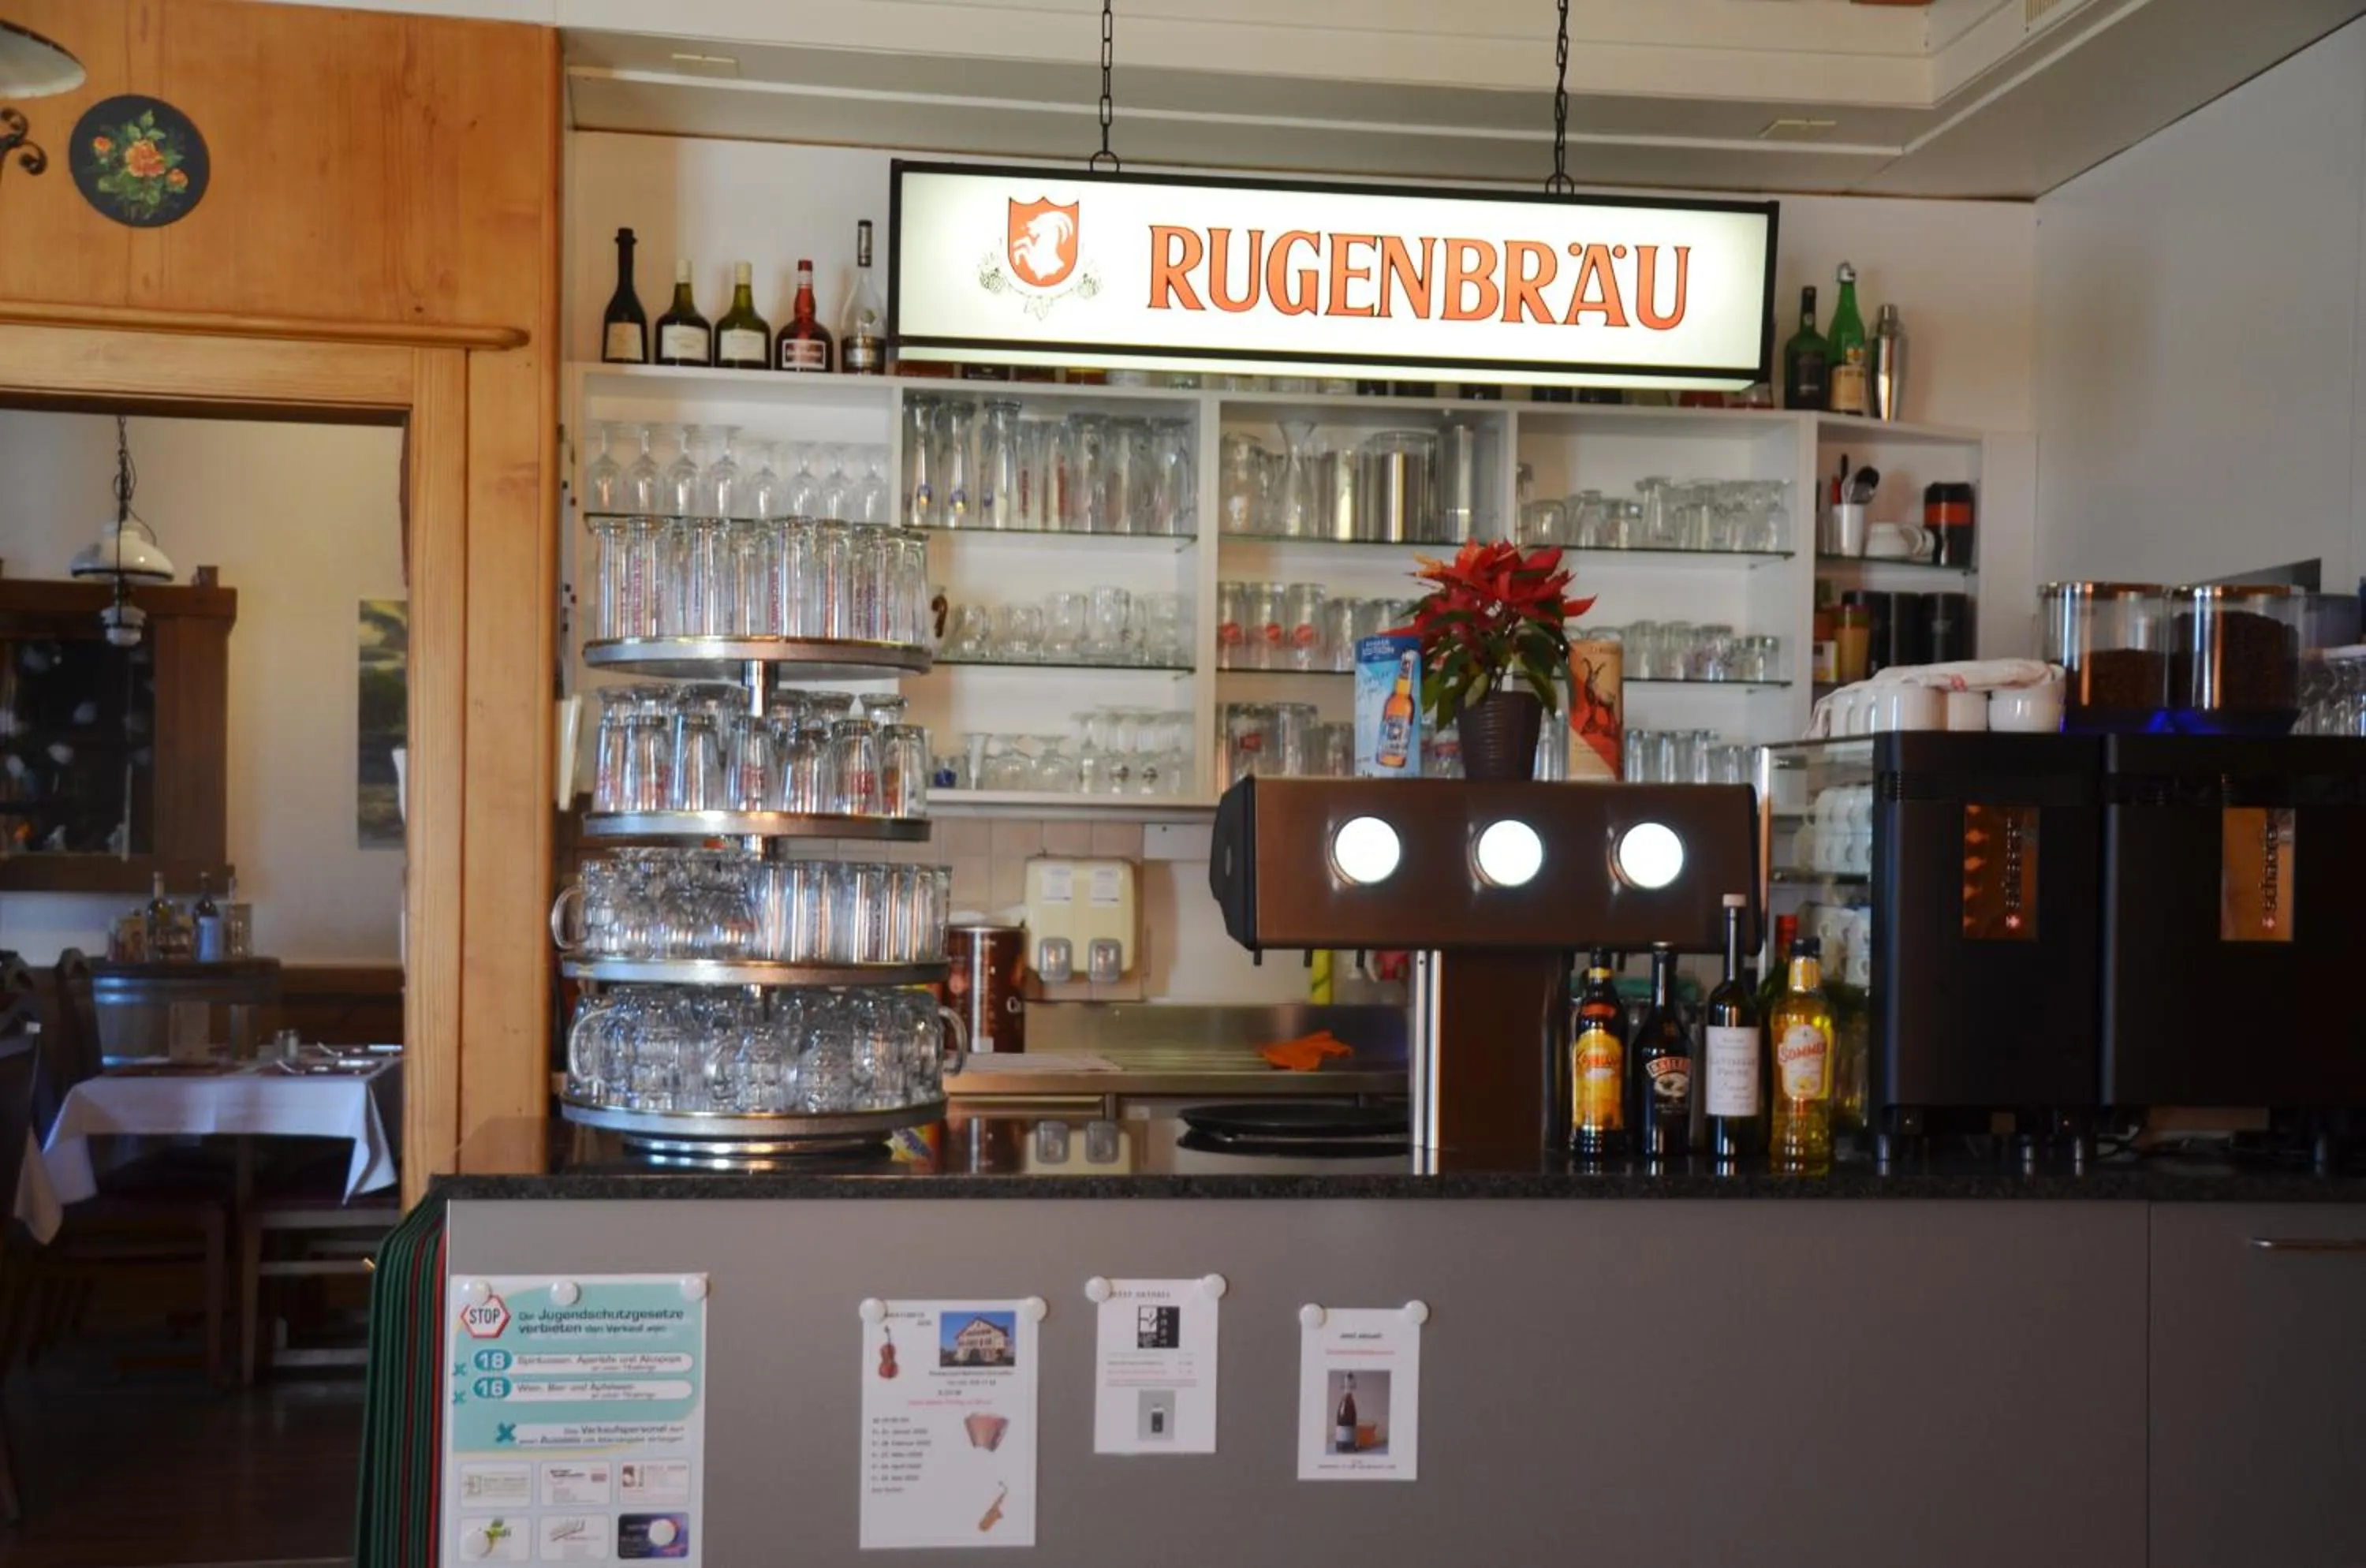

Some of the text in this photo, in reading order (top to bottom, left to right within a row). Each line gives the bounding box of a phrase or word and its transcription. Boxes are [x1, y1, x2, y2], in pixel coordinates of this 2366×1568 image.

[1148, 225, 1691, 330] RUGENBRÄU
[469, 1309, 501, 1324] STOP
[538, 1309, 684, 1322] Jugendschutzgesetze
[519, 1323, 582, 1334] verbieten
[478, 1352, 506, 1368] 18
